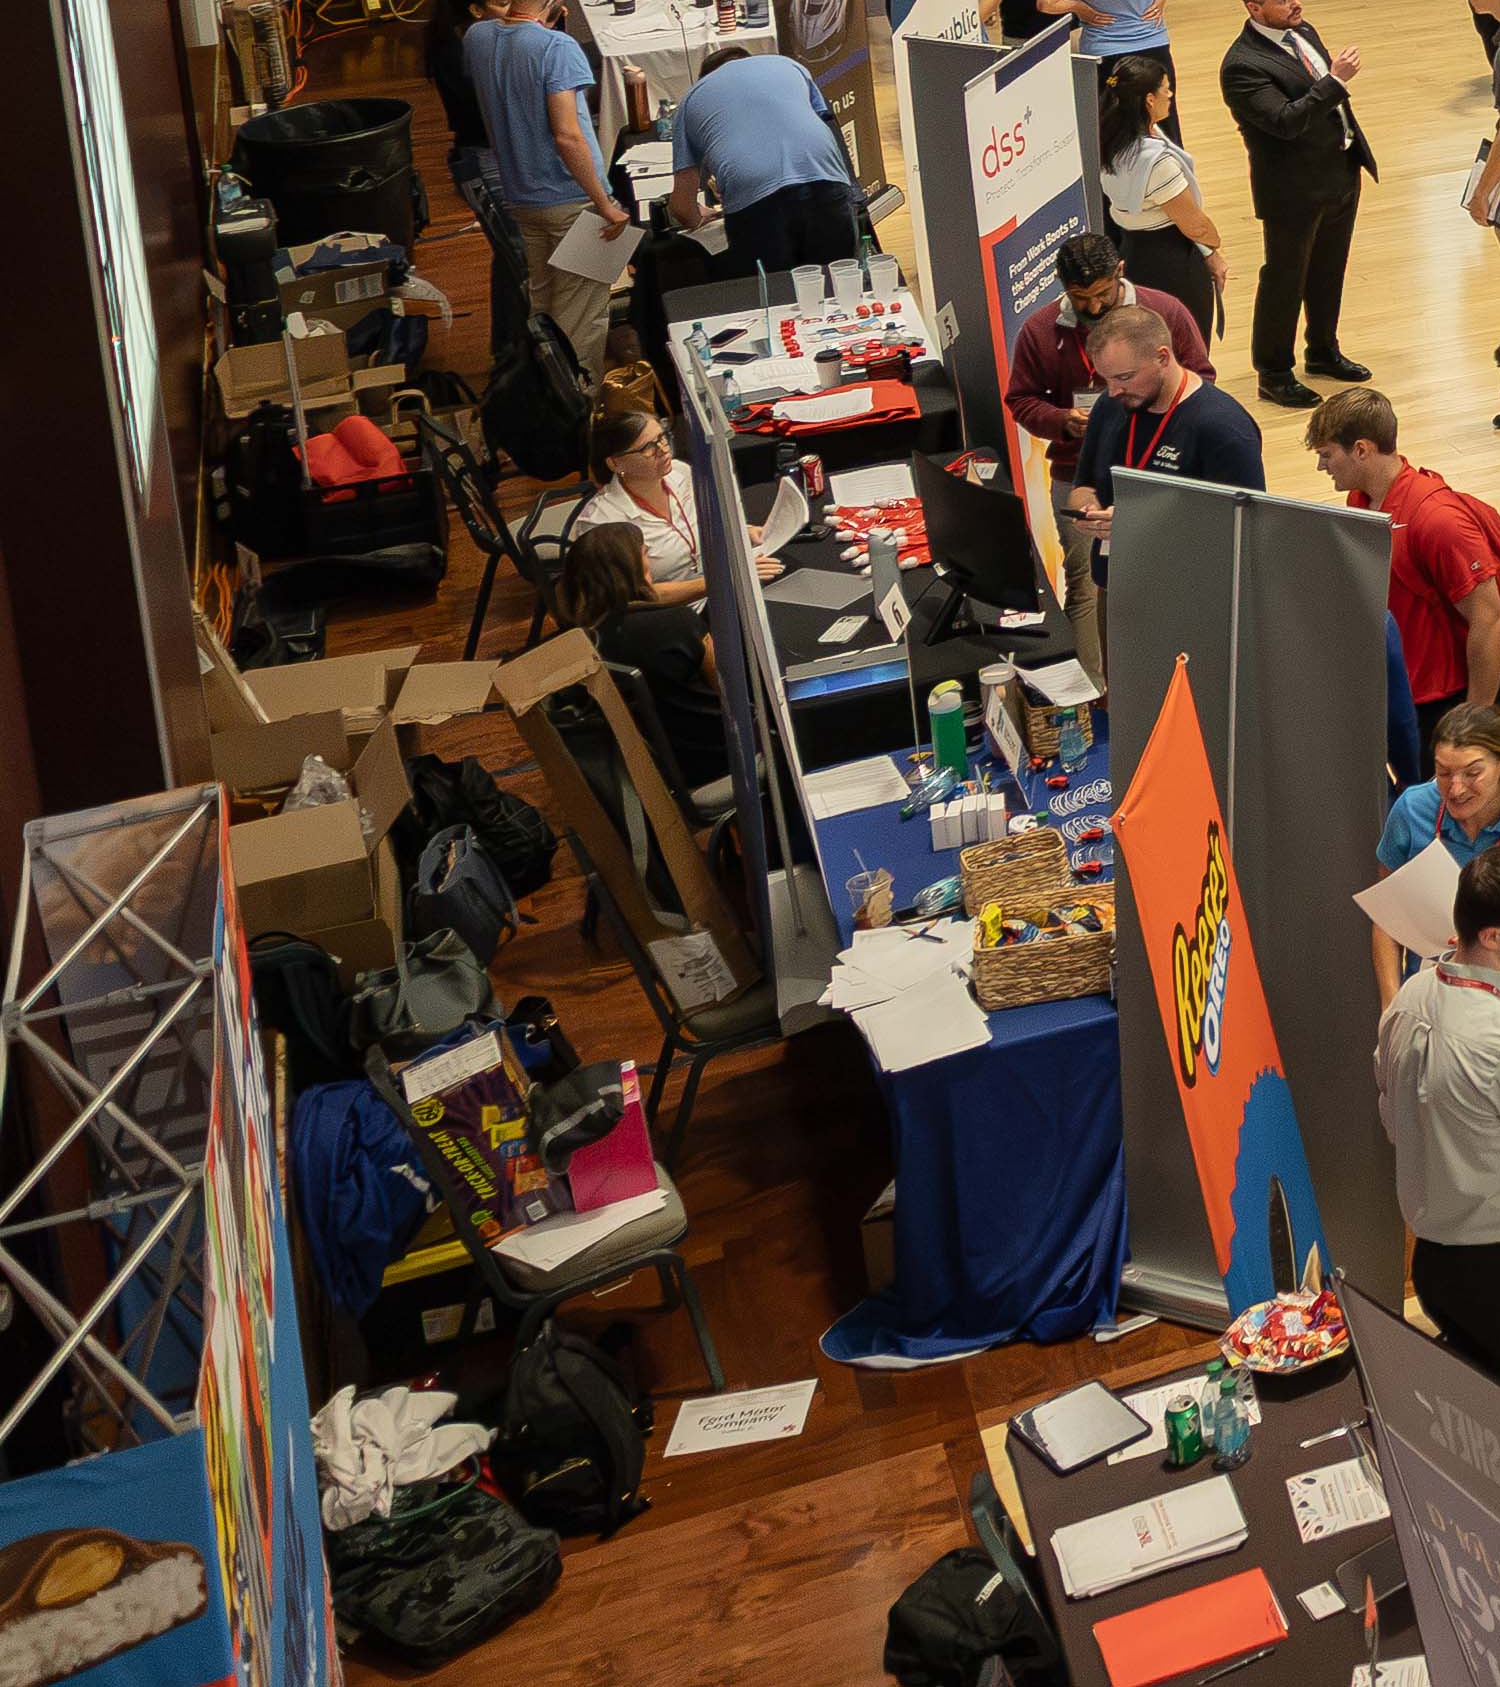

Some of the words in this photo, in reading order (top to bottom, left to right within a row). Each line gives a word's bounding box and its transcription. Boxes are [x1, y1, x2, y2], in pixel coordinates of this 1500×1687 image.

[1009, 252, 1026, 280] From
[1027, 238, 1045, 264] Work
[1045, 222, 1067, 253] Boots
[1011, 276, 1023, 297] the
[1204, 918, 1231, 1065] OREO
[698, 1413, 735, 1426] Ford
[739, 1404, 787, 1419] Motor
[703, 1413, 779, 1431] Company
